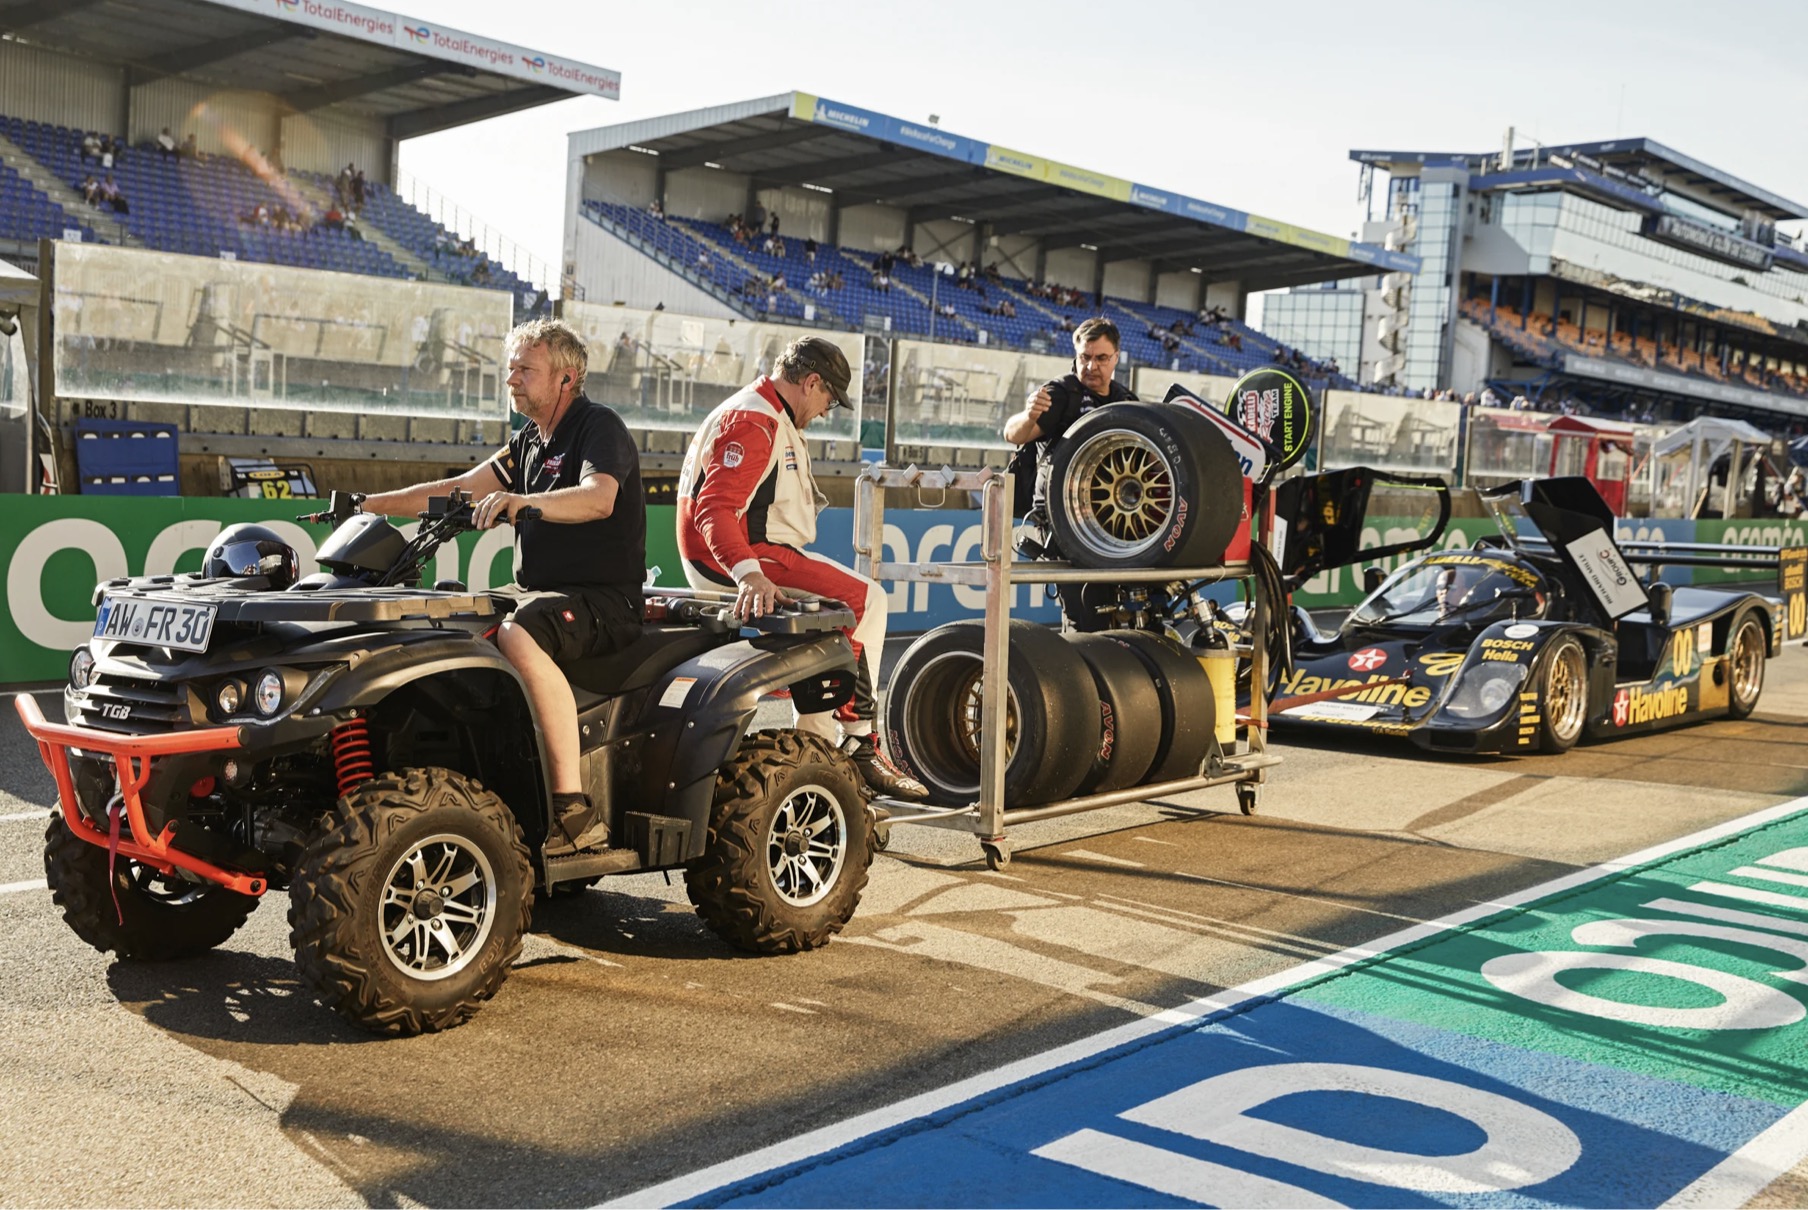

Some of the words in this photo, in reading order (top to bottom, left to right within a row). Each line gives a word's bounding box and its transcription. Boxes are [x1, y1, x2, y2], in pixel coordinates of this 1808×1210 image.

[303, 0, 394, 34] TotalEnergies
[432, 32, 514, 64] TotalEnergies
[547, 62, 620, 91] TotalEnergies
[827, 109, 869, 127] MICHELIN
[85, 400, 106, 418] Box
[109, 401, 117, 419] 3
[1284, 382, 1293, 419] ENGINE
[1284, 421, 1293, 452] START
[262, 481, 292, 499] 62
[1164, 495, 1188, 553] AVON
[1578, 553, 1593, 575] MILLE
[1591, 573, 1613, 604] RICHARD
[105, 603, 137, 637] AW
[143, 606, 177, 641] FR
[175, 608, 210, 645] 30
[1789, 592, 1806, 636] 00
[1481, 638, 1534, 651] BOSCH
[1482, 649, 1518, 662] Hella
[1673, 628, 1693, 677] 00
[1268, 668, 1431, 707] Havoline
[1628, 680, 1688, 725] Havoline
[102, 703, 131, 720] TGB
[1100, 701, 1114, 760] AVON
